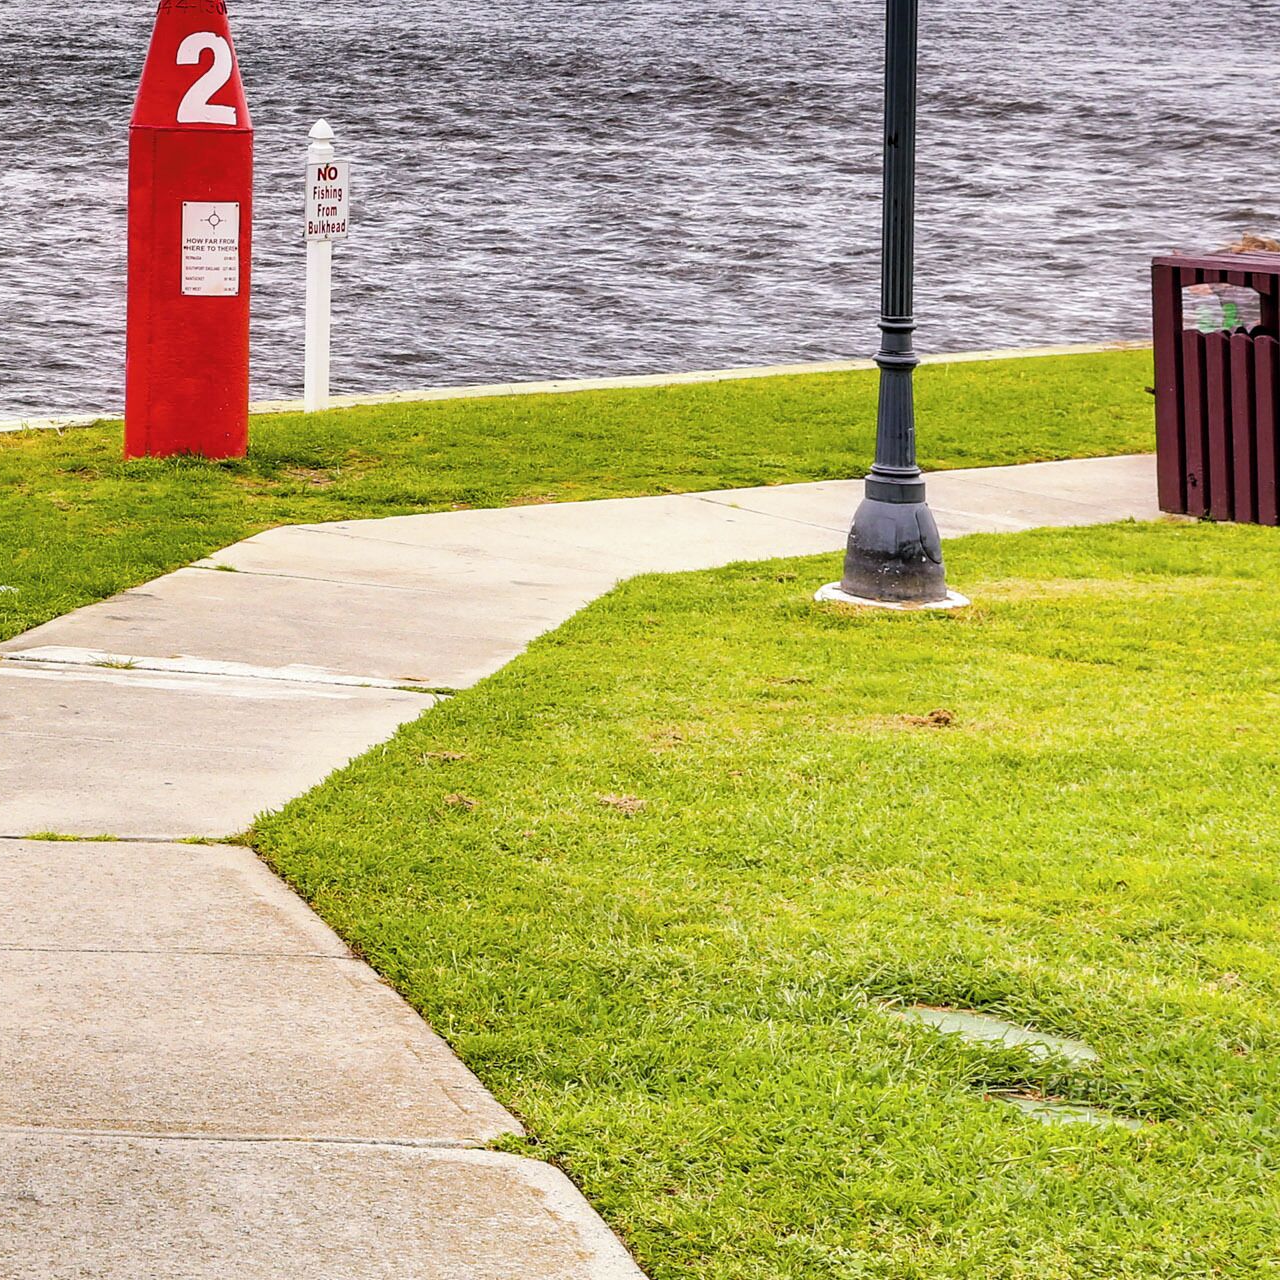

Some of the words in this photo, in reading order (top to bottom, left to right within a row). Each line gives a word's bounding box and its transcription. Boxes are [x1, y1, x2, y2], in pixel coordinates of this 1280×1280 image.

[175, 31, 237, 125] 2
[317, 166, 338, 181] NO
[313, 186, 342, 202] Fishing
[317, 204, 337, 217] From
[308, 219, 346, 235] Bulkhead
